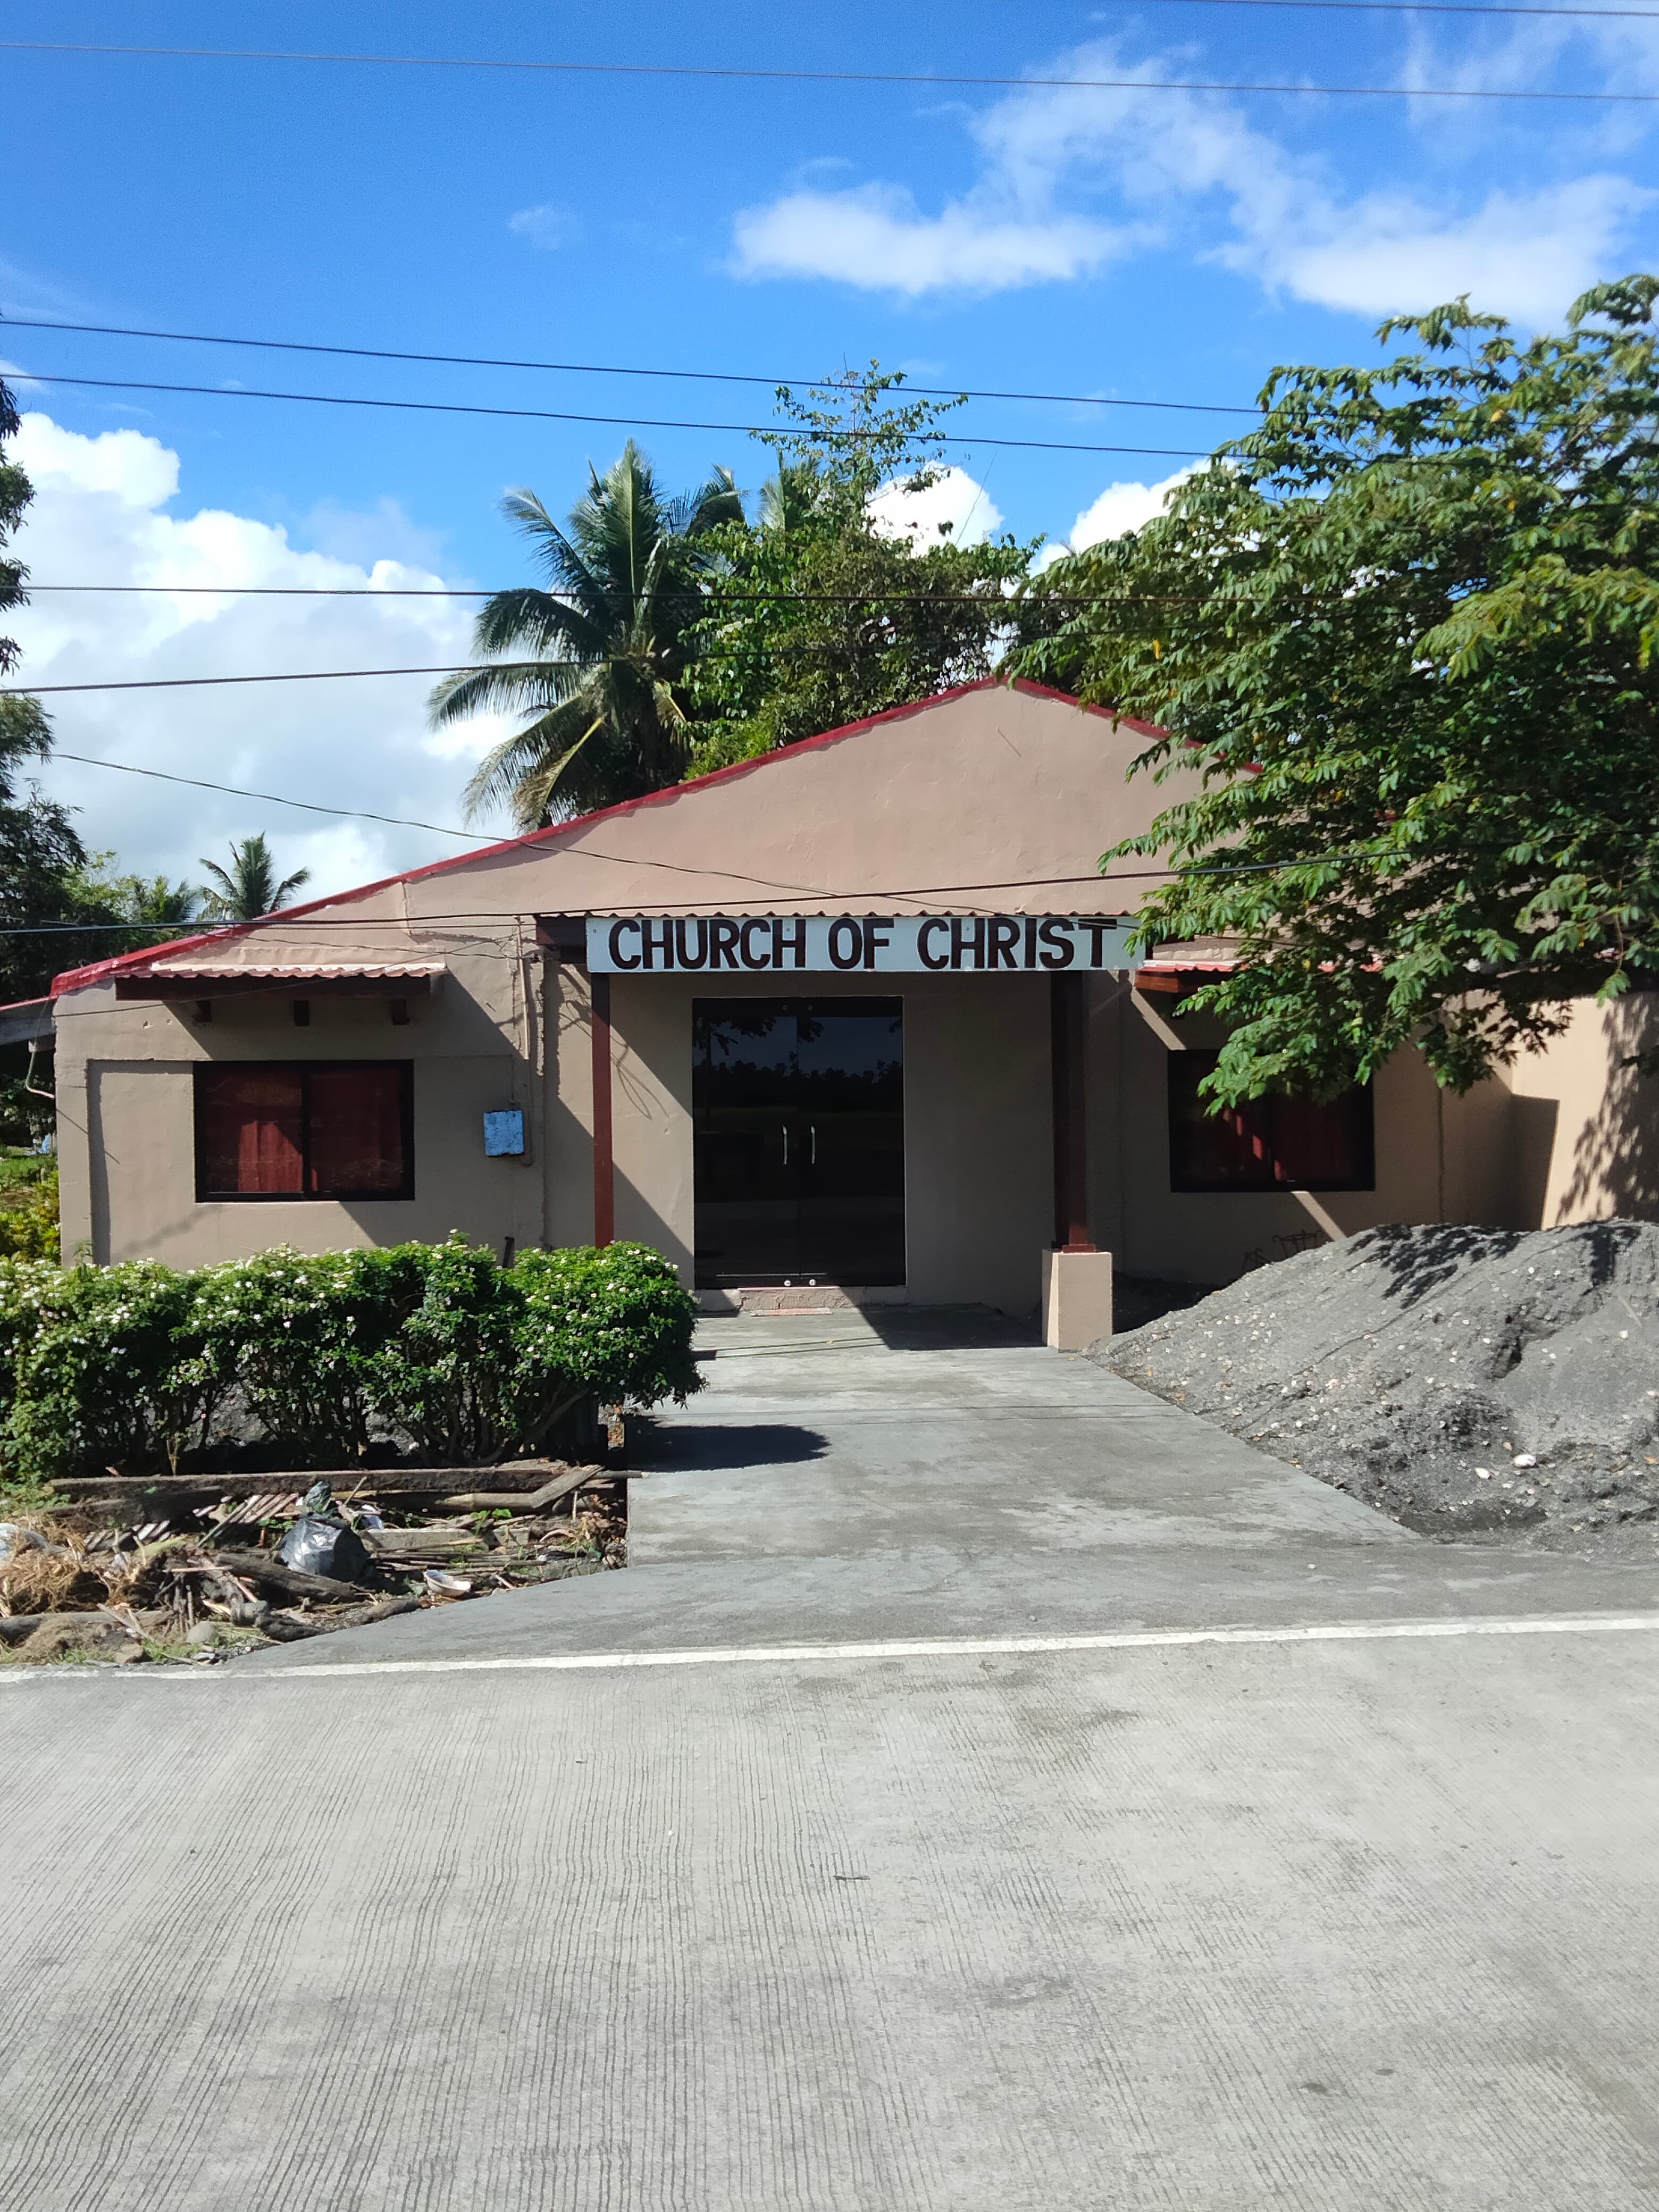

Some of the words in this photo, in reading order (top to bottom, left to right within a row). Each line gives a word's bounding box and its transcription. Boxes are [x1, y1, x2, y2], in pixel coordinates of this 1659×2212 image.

[608, 919, 806, 969] CHURCH
[828, 919, 895, 969] OF
[917, 918, 1117, 969] CHRIST
